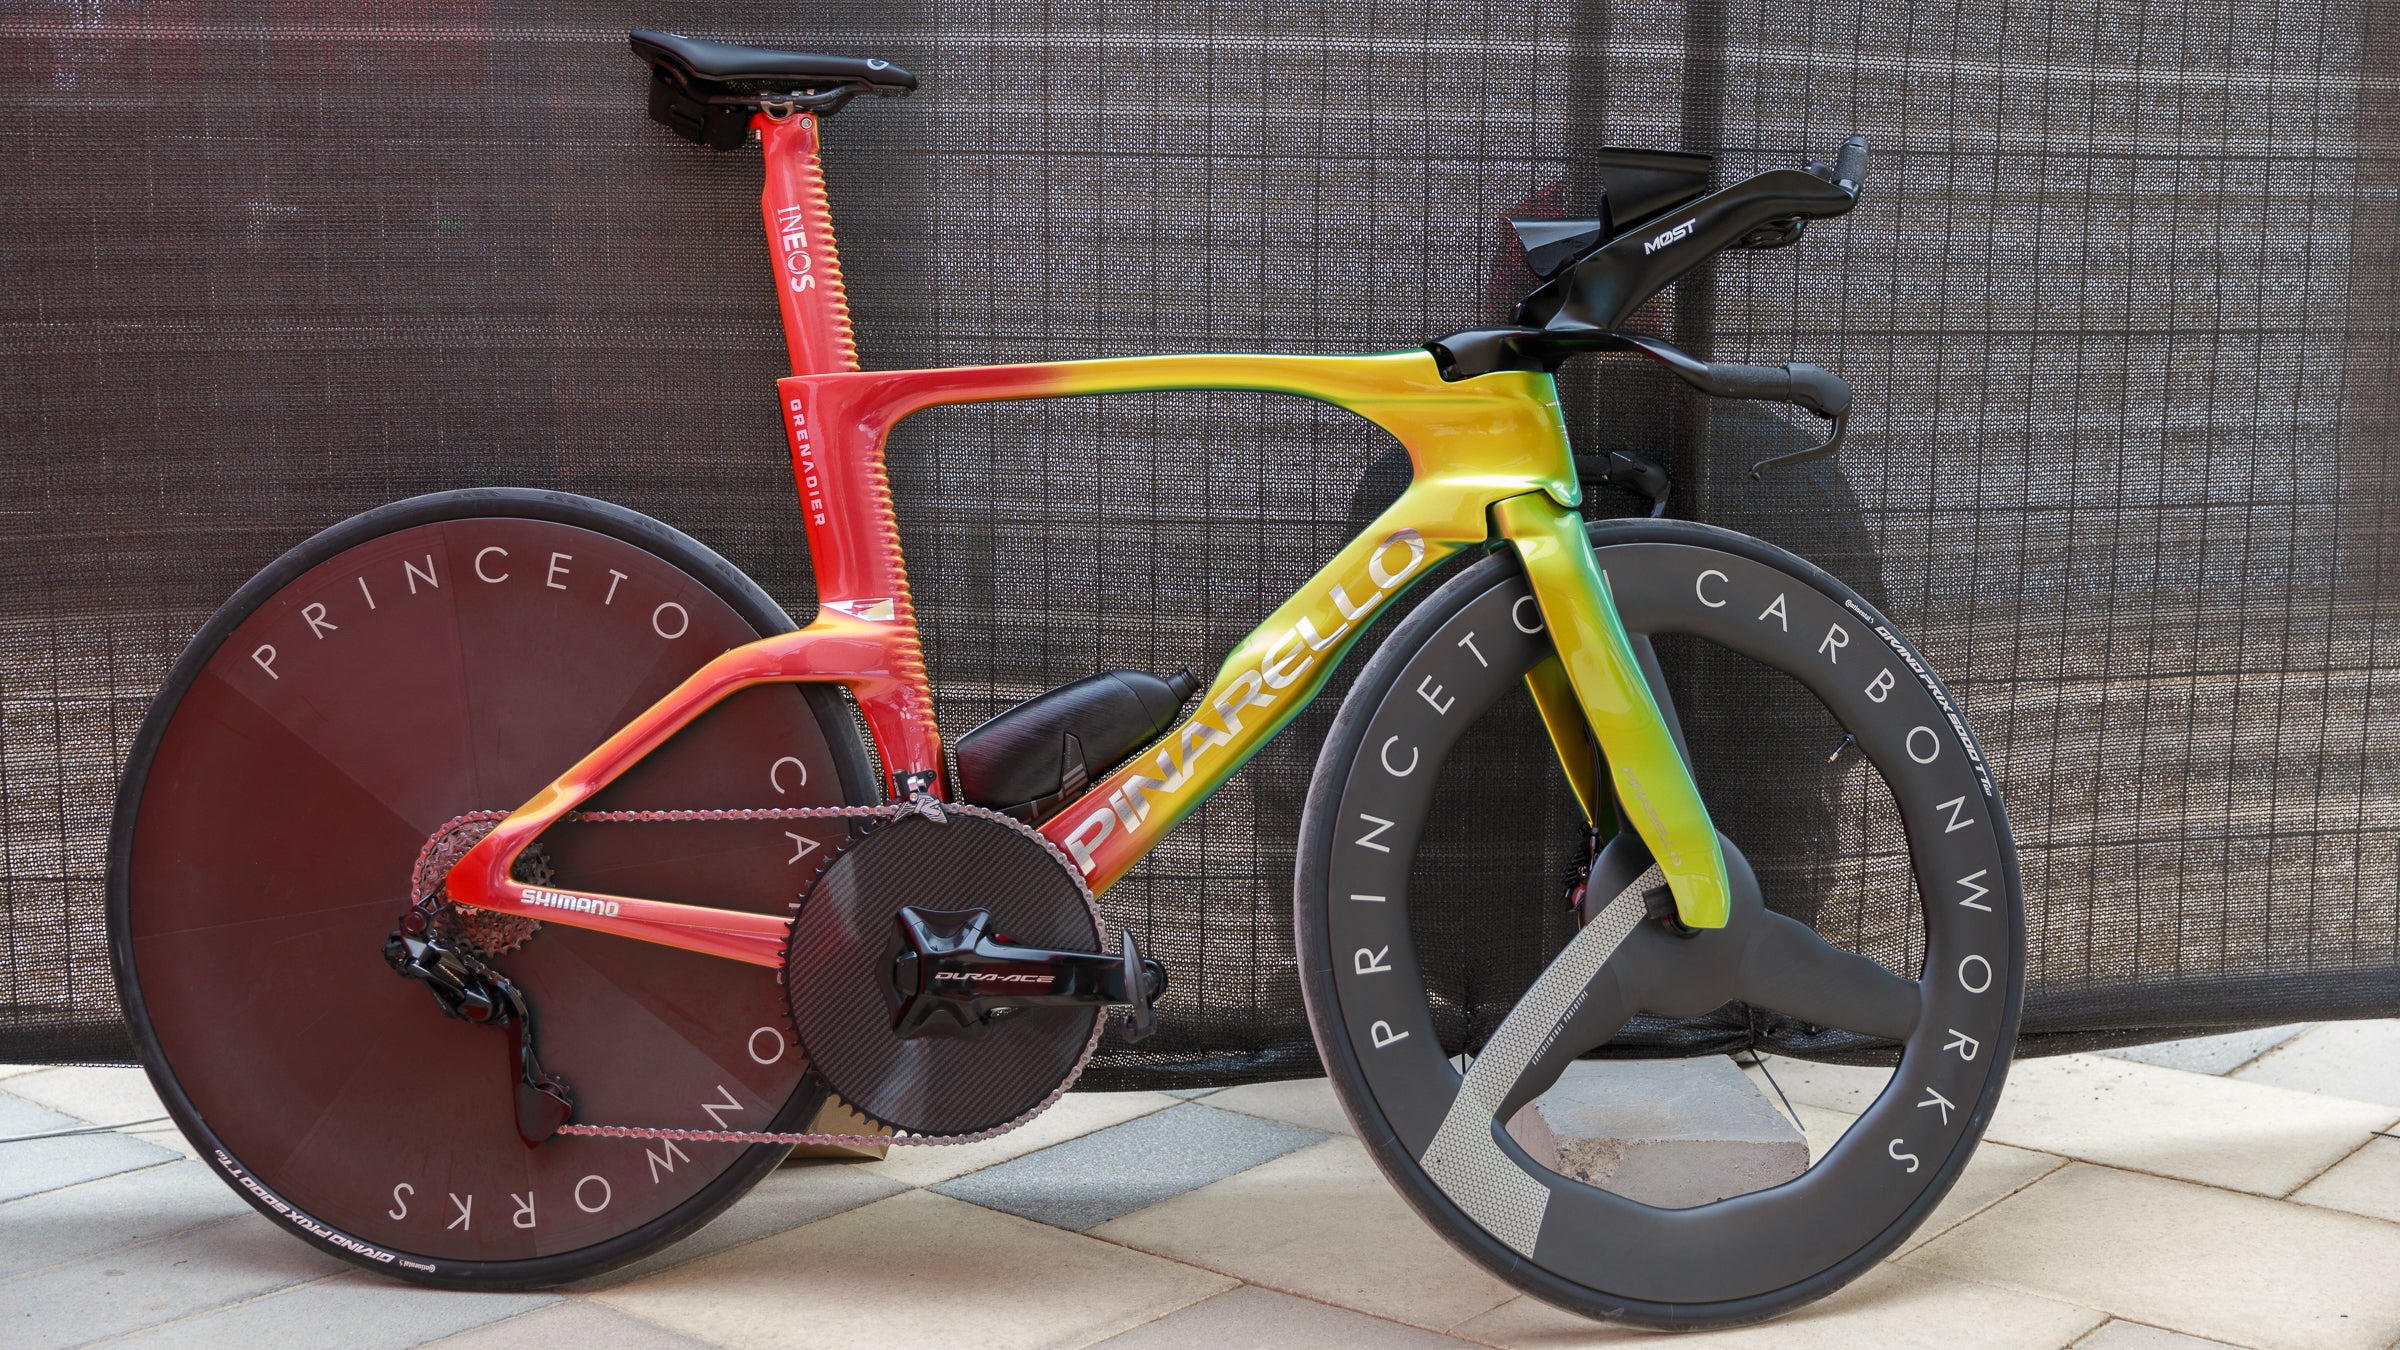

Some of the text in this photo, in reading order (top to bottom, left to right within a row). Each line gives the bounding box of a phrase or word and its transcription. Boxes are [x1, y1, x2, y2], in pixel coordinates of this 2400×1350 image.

[777, 204, 816, 293] INEOS
[790, 398, 826, 527] GRENADIER
[251, 546, 690, 680] PRINCETO
[1064, 527, 1425, 876] PINARELLO
[1874, 625, 1926, 675] GRAND
[1919, 672, 1954, 713] PRIX
[1950, 712, 1981, 763] 5000
[1354, 570, 1613, 1050] PRINCETO
[520, 888, 620, 918] SHIMANO
[934, 971, 1056, 984] DURA-ACE
[239, 1176, 291, 1214] 5000
[285, 1210, 329, 1239] PRIX
[329, 1233, 396, 1264] GRAND
